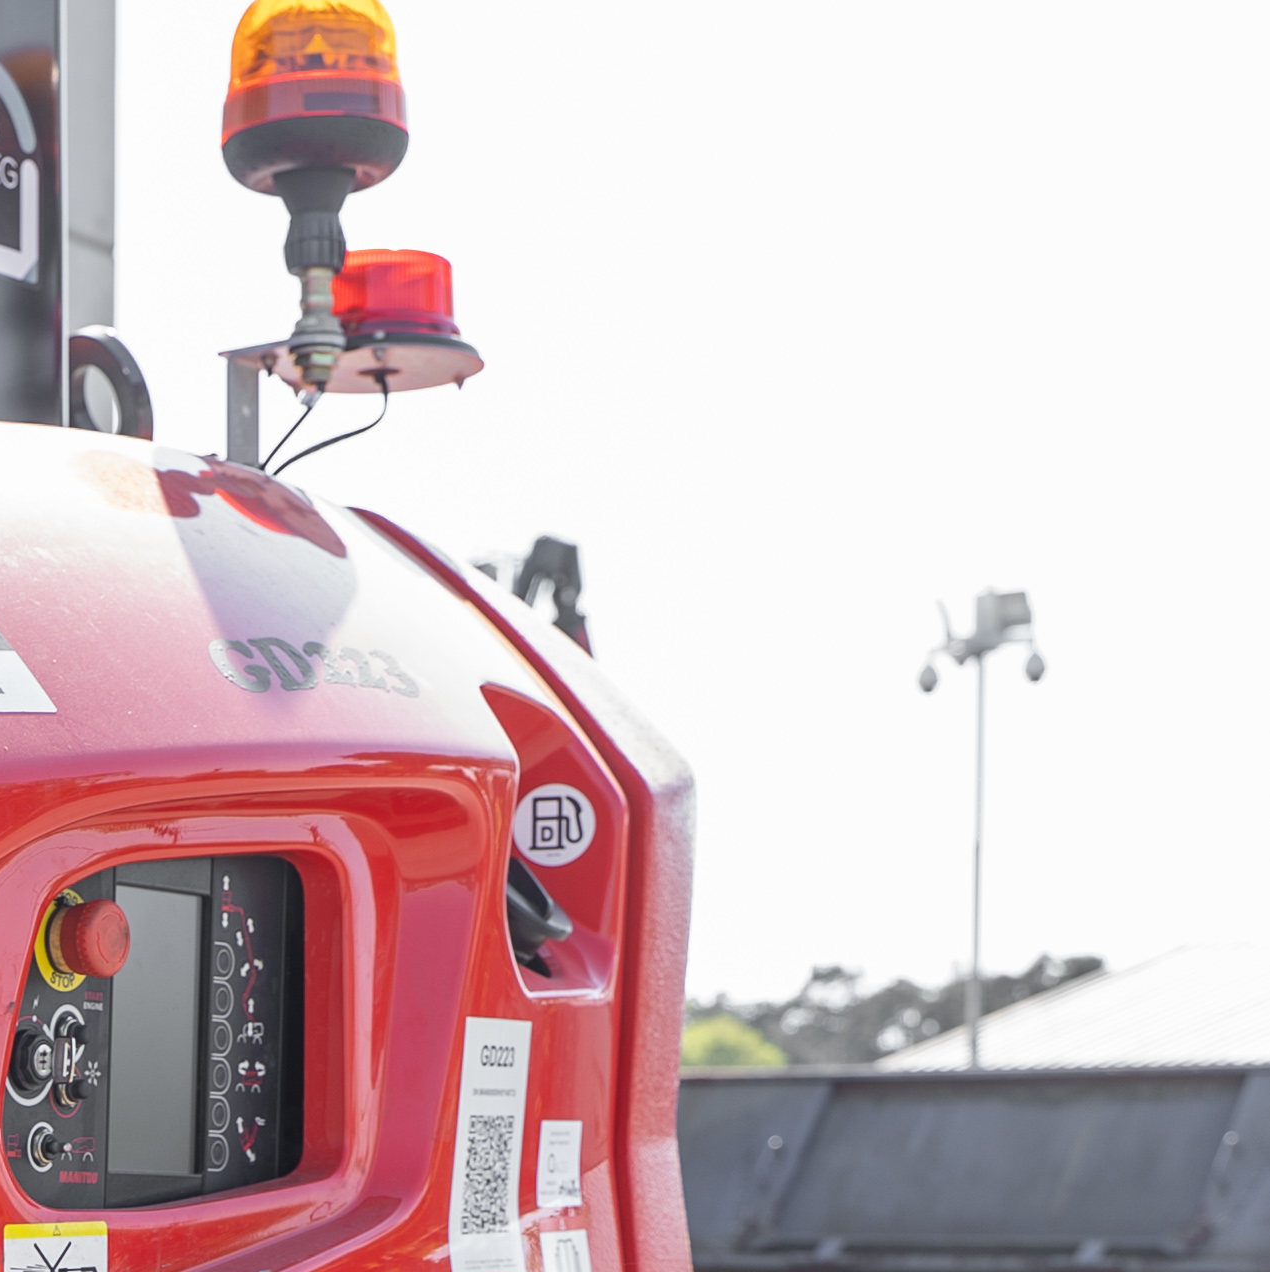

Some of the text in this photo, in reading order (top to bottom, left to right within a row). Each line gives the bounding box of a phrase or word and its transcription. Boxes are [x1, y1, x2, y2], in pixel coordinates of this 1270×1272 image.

[50, 971, 76, 989] STOP
[83, 1001, 103, 1011] ENGINE
[480, 1045, 515, 1068] GD223
[59, 1170, 99, 1184] MANITOU
